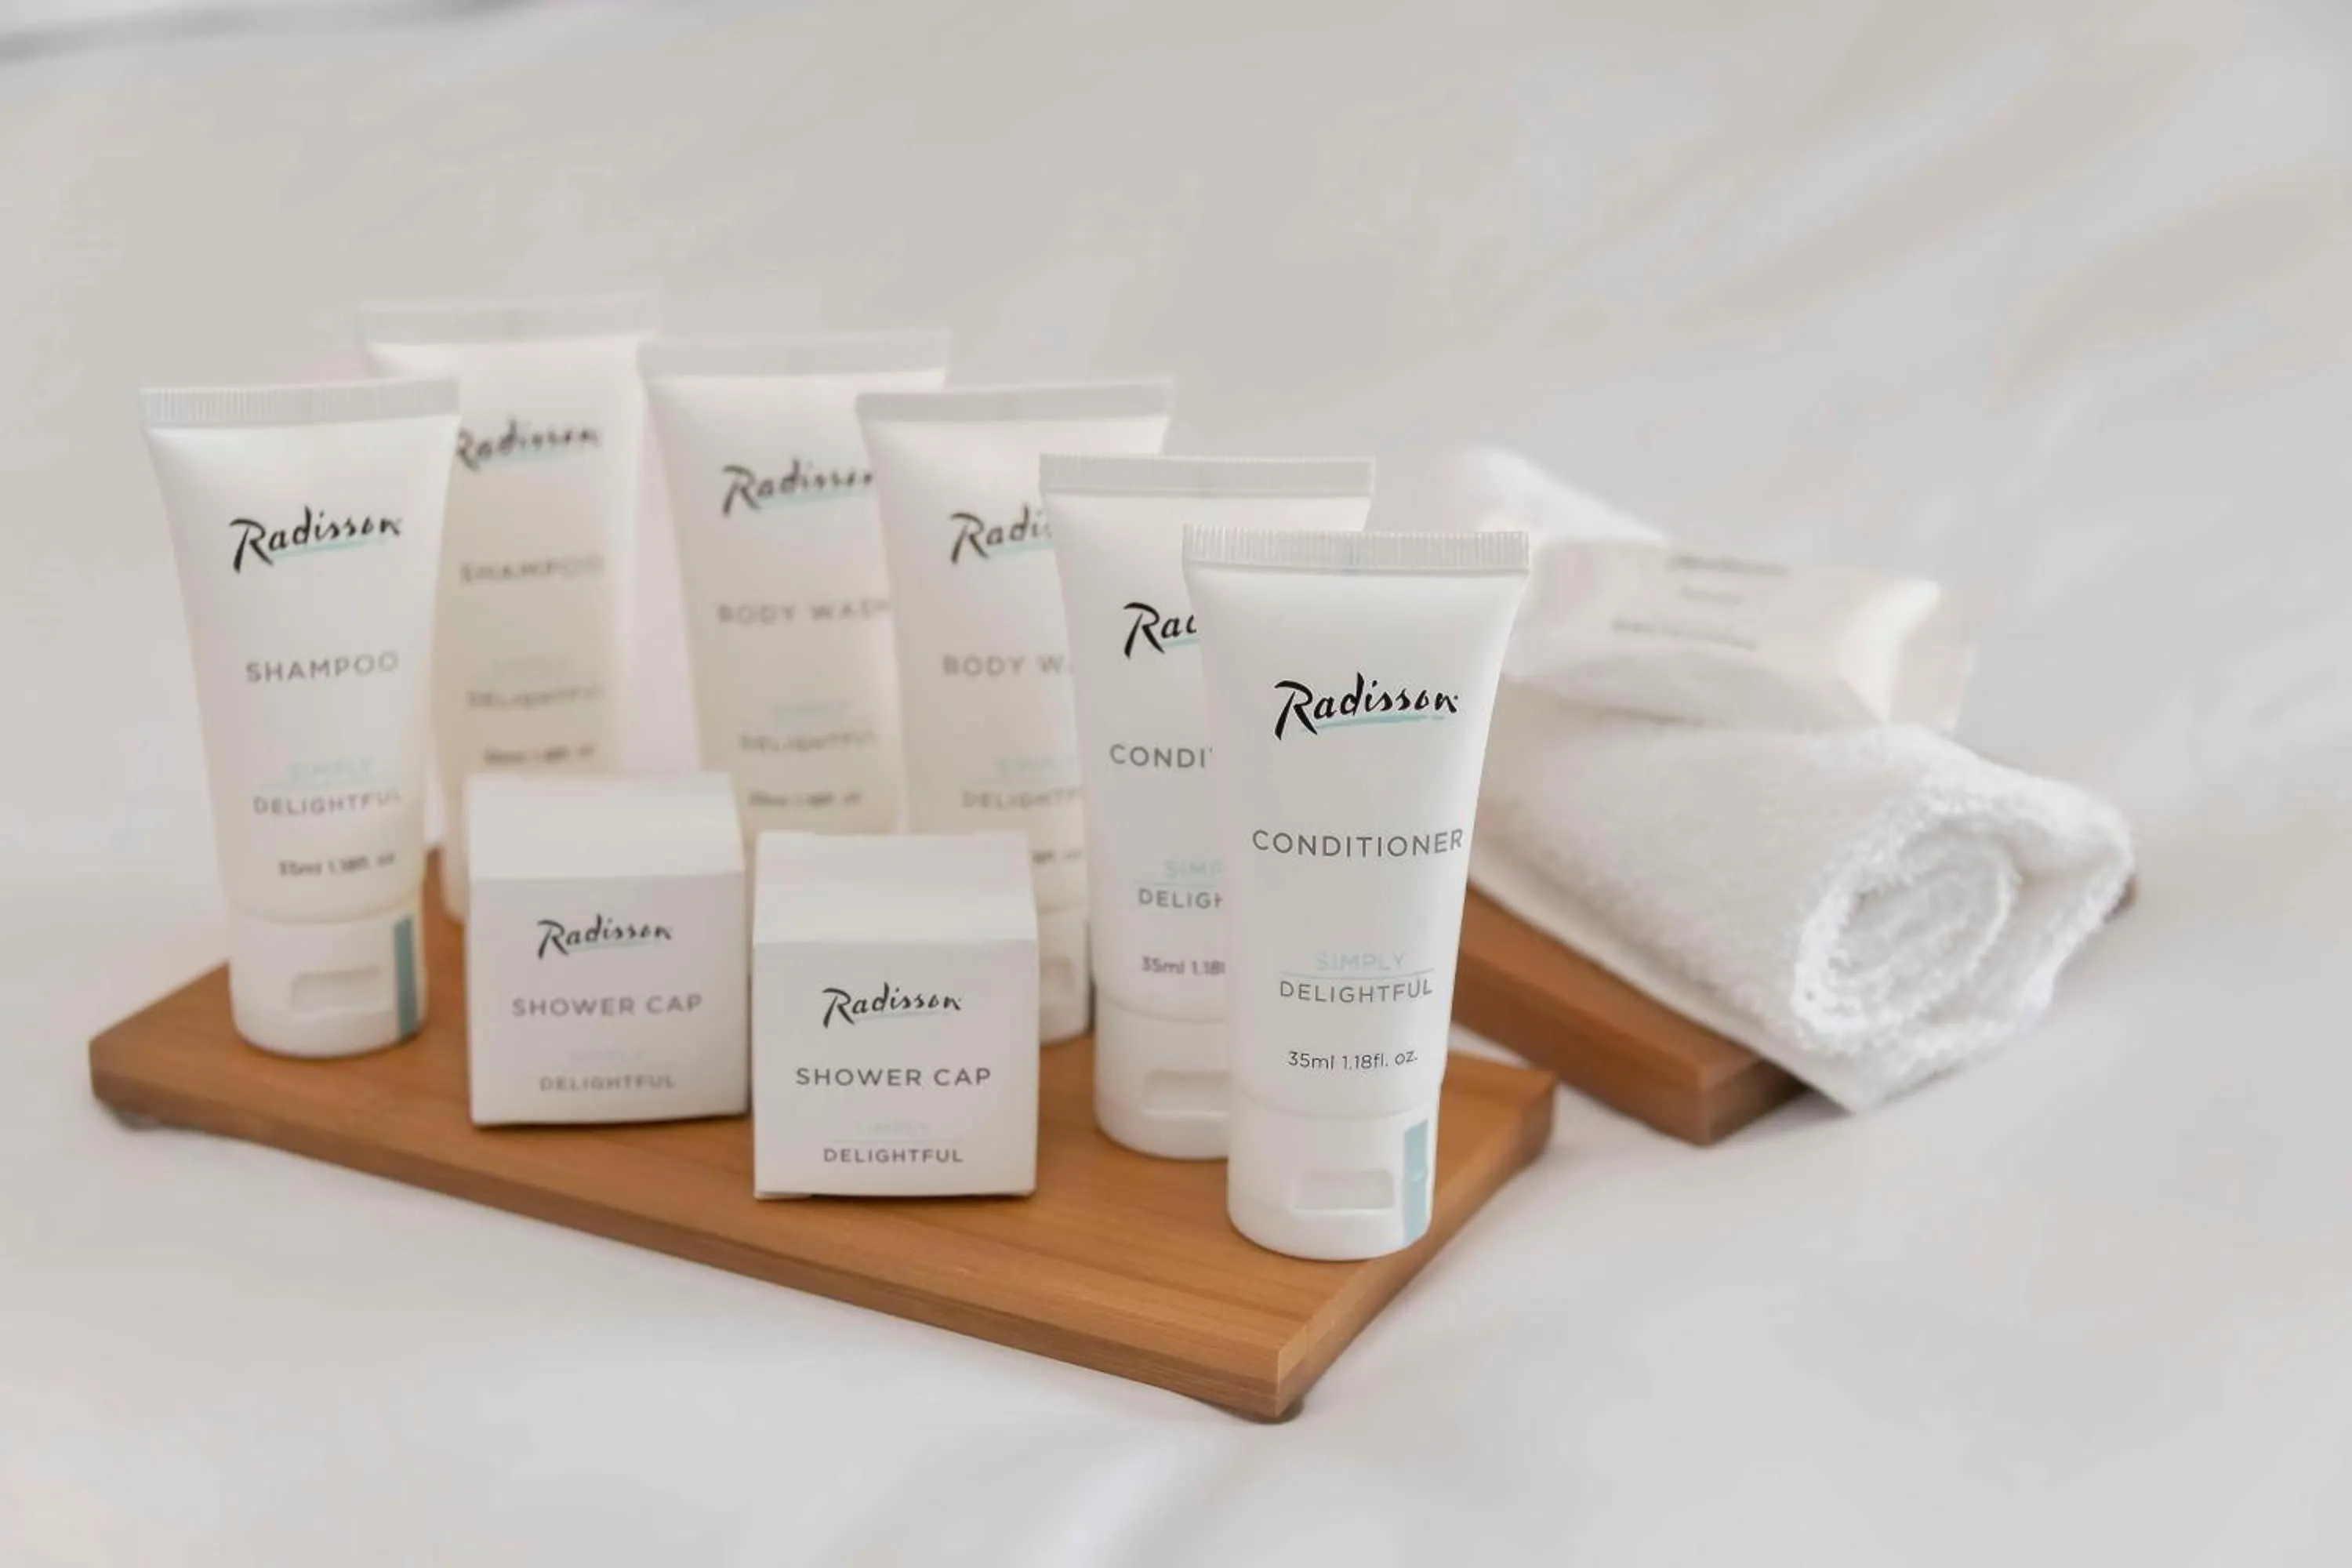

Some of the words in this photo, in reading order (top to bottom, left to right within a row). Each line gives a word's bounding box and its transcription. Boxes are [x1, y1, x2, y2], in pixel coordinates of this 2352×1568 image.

[229, 504, 404, 574] Radisson
[717, 603, 795, 626] BODY
[245, 649, 399, 683] SHAMPOO
[942, 653, 1025, 677] BODY
[1274, 671, 1458, 740] Radisson
[1109, 743, 1213, 768] CONDI
[1252, 828, 1463, 858] CONDITIONER
[1165, 859, 1224, 879] SIMP
[537, 913, 674, 960] Radisson
[1316, 951, 1406, 971] SIMPLY
[1279, 977, 1433, 1004] DELIGHTFUL
[511, 996, 636, 1018] SHOWER
[645, 993, 703, 1014] CAP
[822, 981, 963, 1029] Radisson
[1288, 1050, 1334, 1070] 35ml
[1341, 1053, 1388, 1071] 1.18fl.
[539, 1073, 677, 1092] DELIGHTFUL
[796, 1067, 923, 1087] SHOWER
[933, 1067, 993, 1087] CAP
[823, 1148, 964, 1163] DELIGHTFUL
